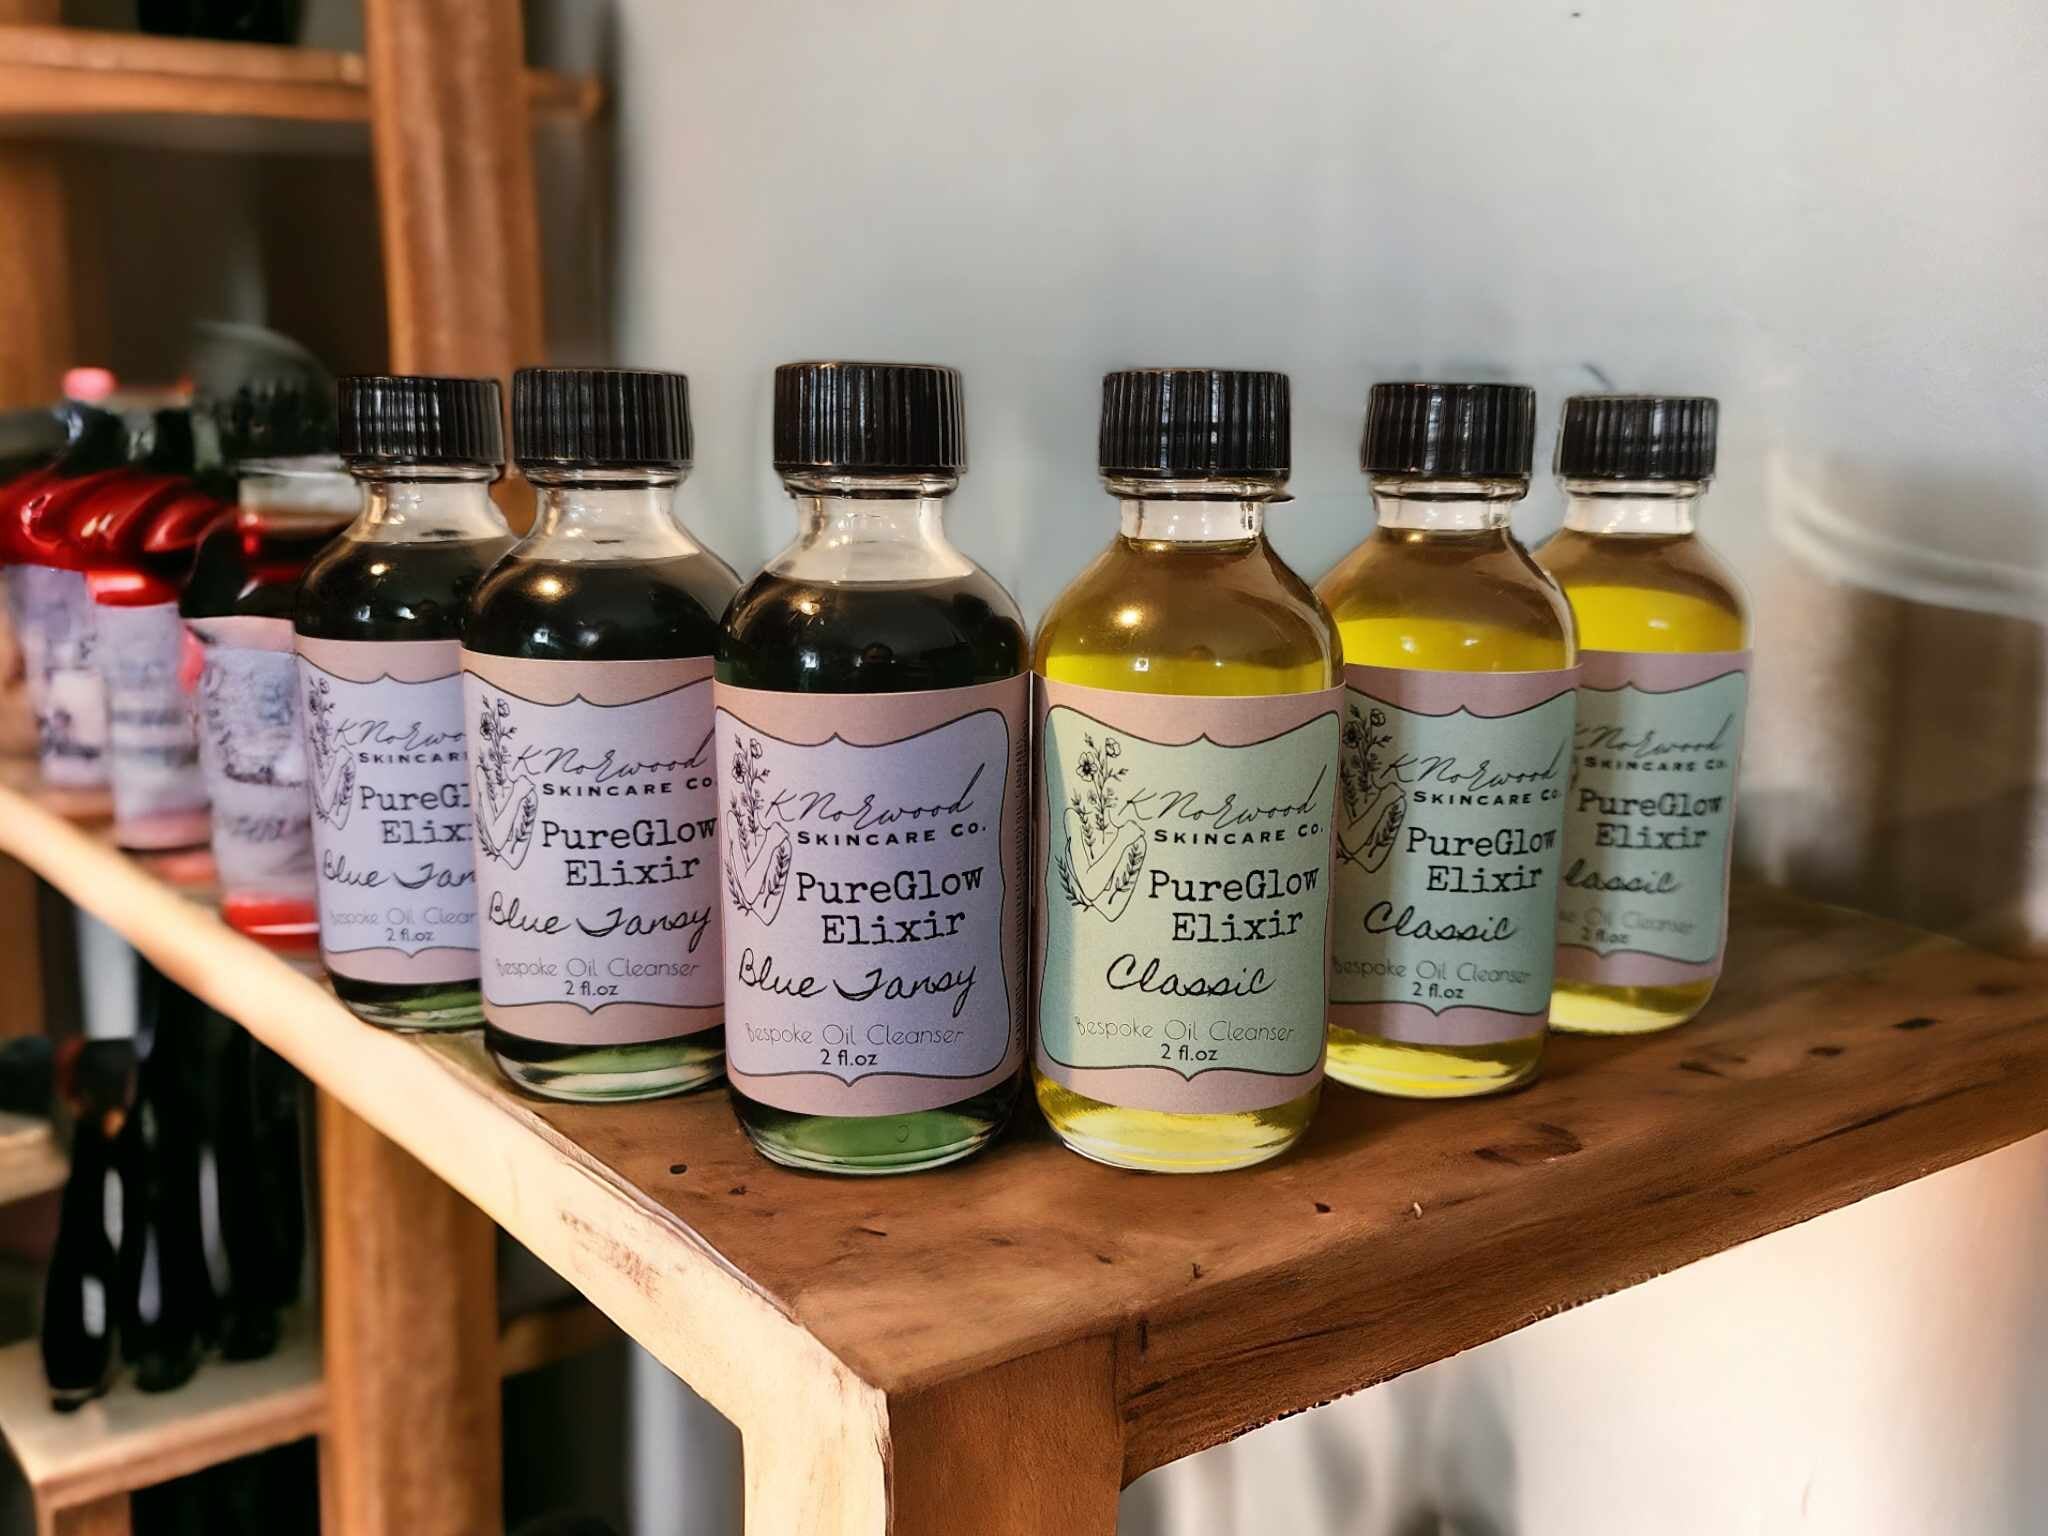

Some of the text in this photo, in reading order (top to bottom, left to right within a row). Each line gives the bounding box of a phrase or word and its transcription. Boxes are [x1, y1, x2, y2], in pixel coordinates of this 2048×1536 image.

[359, 752, 467, 764] SKINCAR
[1584, 756, 1696, 772] SKINCARE
[359, 783, 470, 811] PureG
[543, 783, 673, 796] SKINCARE
[1413, 790, 1532, 806] SKINCARE
[1576, 788, 1723, 817] PureGlow
[381, 820, 472, 844] Elix
[541, 817, 717, 849] PureGlow
[797, 830, 936, 846] SKINCARE
[1154, 829, 1286, 845] SKINCARE
[1406, 826, 1557, 857] PureGlow
[1595, 822, 1708, 849] Elixir
[323, 849, 476, 890] Blue Tan
[564, 855, 700, 887] Elixir
[1426, 865, 1542, 893] Elixir
[1563, 858, 1682, 894] lassic
[796, 866, 984, 904] PureGlow
[1148, 867, 1320, 902] PureGlow
[386, 907, 415, 925] Oil
[489, 891, 712, 953] Blue Tansy
[821, 910, 966, 946] Elixir
[1172, 909, 1303, 943] Elixir
[1363, 900, 1518, 943] Classic
[386, 928, 397, 942] 2
[566, 957, 600, 977] Oil
[608, 957, 700, 977] Cleanser
[1106, 953, 1277, 997] Classic
[1416, 960, 1447, 980] Oil
[1457, 962, 1531, 984] Cleanser
[564, 980, 619, 996] 2 fl.oz
[738, 947, 977, 1018] Blue Tansy
[1412, 981, 1464, 999] 2 fl.oz
[822, 1024, 857, 1046] Oil
[866, 1024, 965, 1046] Cleanser
[1164, 1019, 1198, 1041] Oil
[1208, 1020, 1295, 1042] Cleanser
[820, 1048, 879, 1067] 2 fl.oz
[1160, 1043, 1218, 1061] 2 fl.oz
